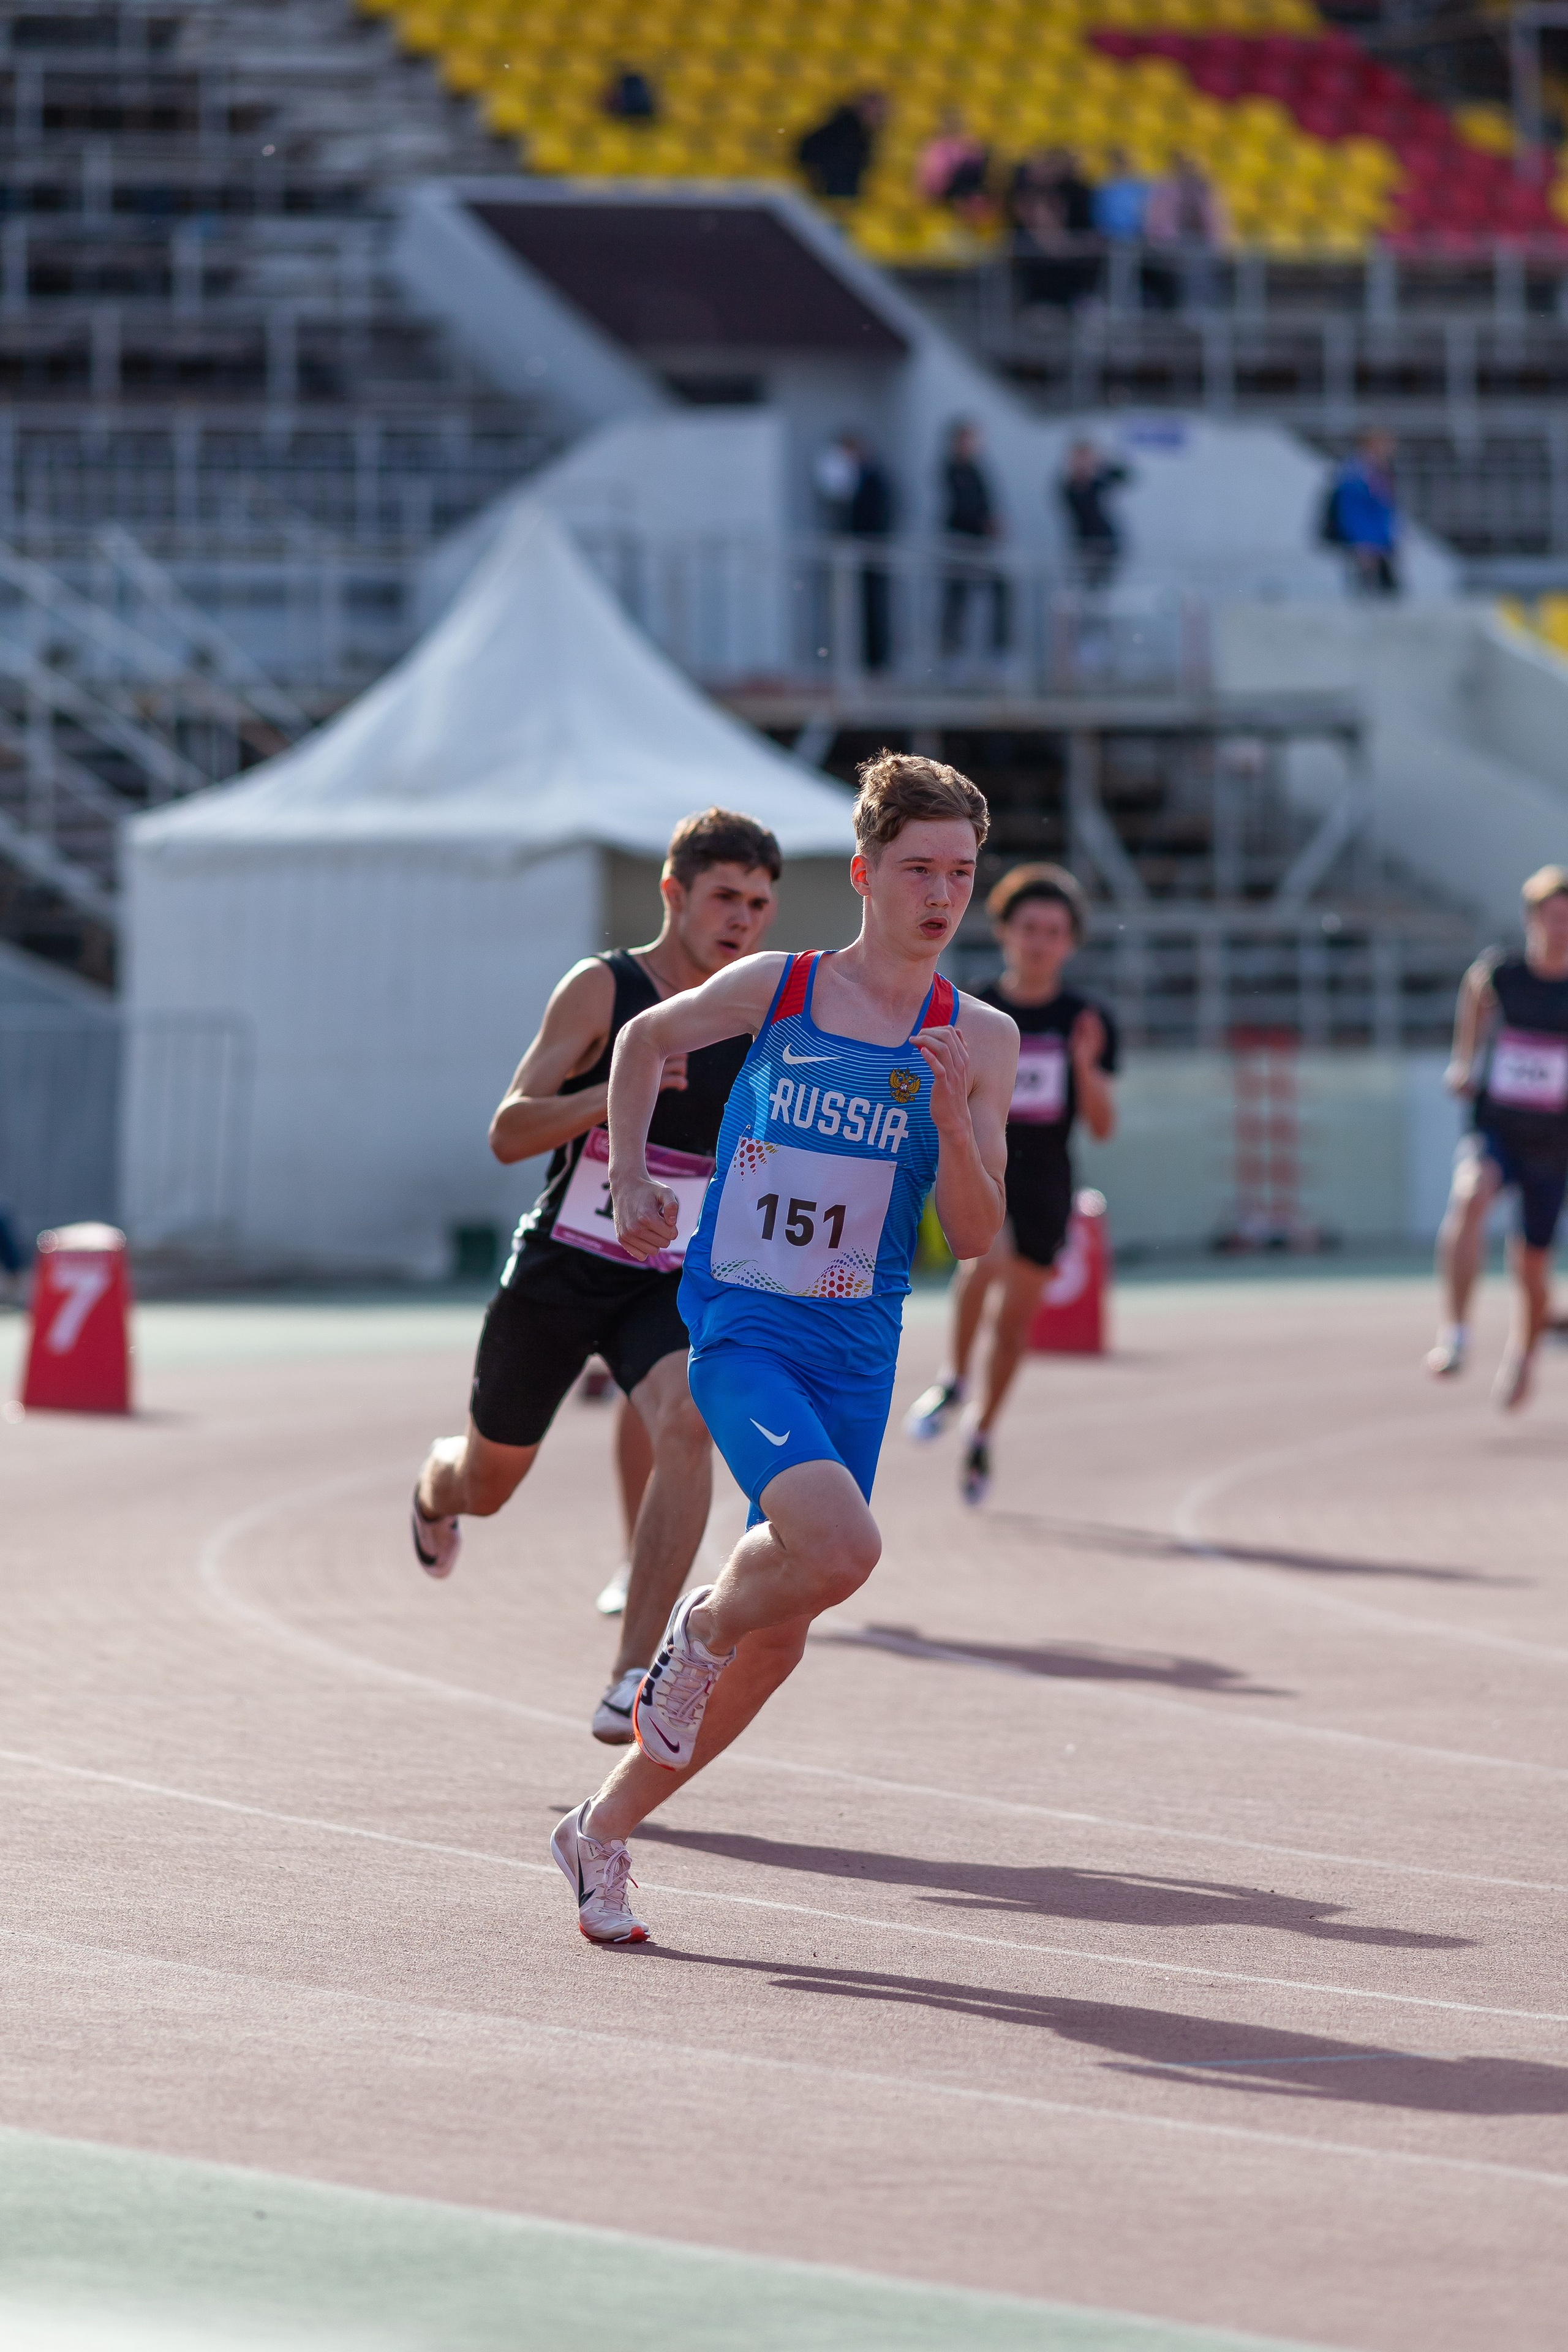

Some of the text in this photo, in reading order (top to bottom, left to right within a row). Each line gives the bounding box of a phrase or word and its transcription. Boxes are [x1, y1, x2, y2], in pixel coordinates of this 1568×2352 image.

[769, 1077, 909, 1153] RUSSIA
[756, 1193, 846, 1249] 151
[48, 1263, 109, 1353] 7
